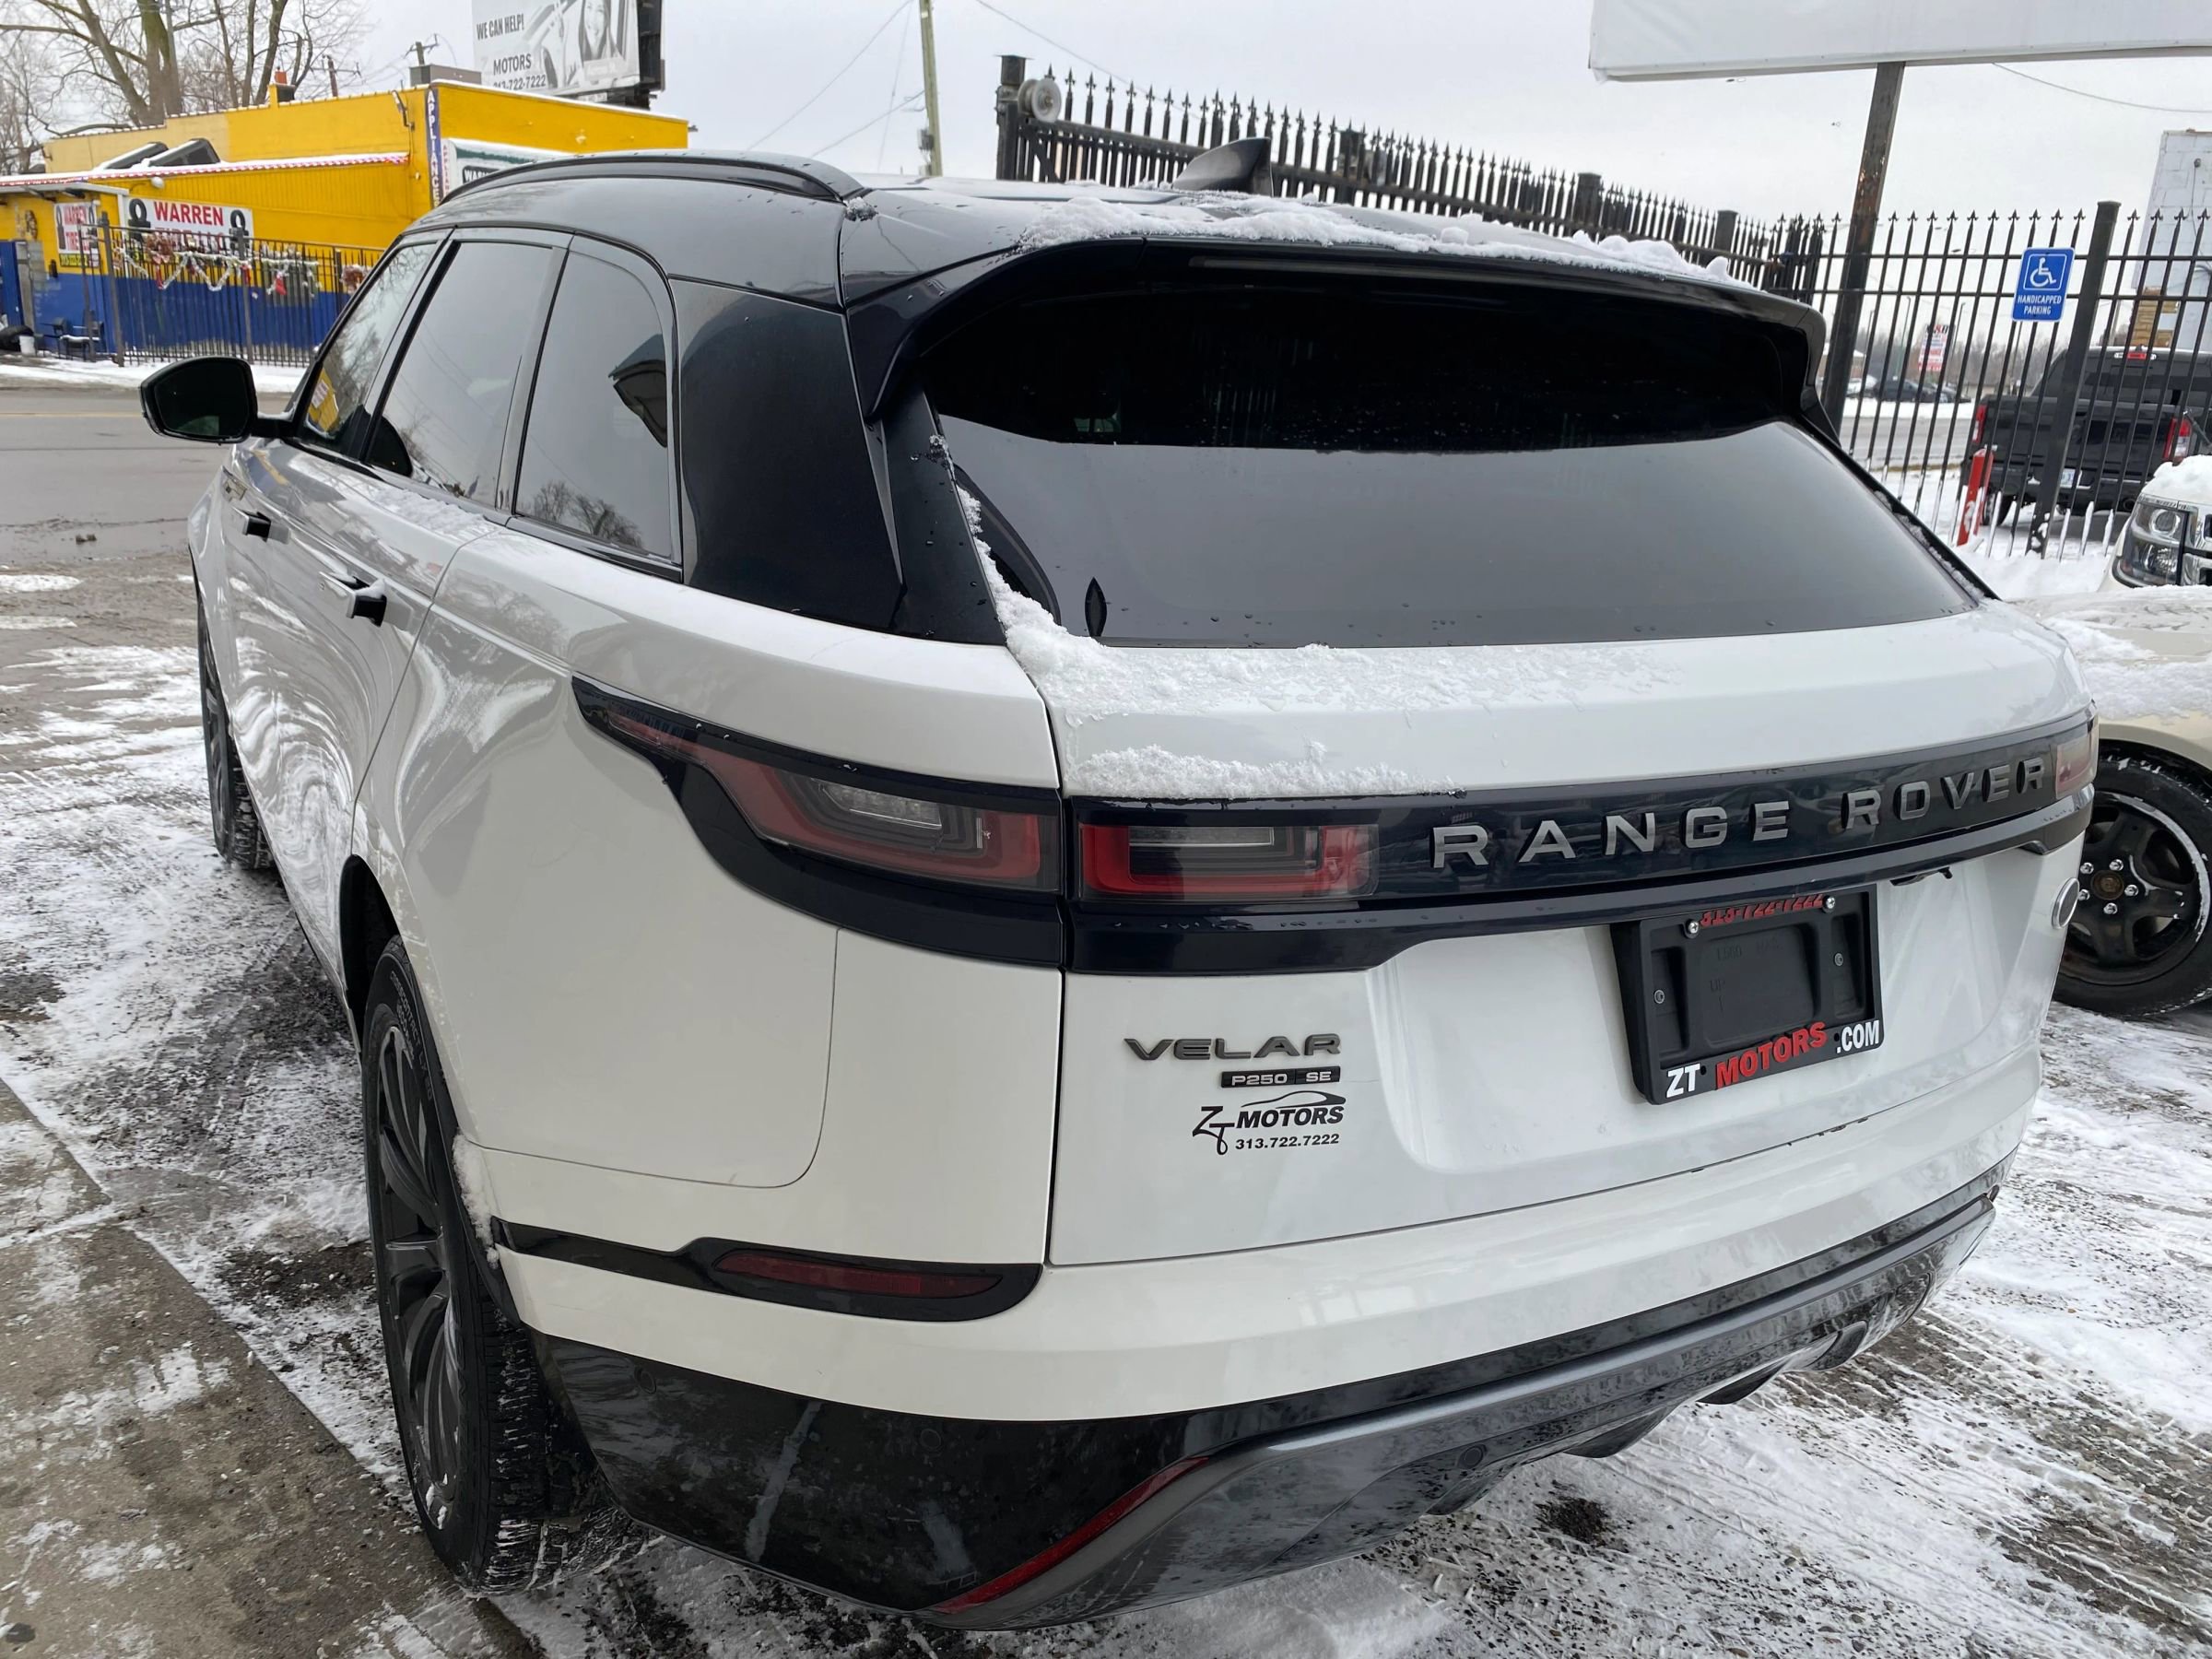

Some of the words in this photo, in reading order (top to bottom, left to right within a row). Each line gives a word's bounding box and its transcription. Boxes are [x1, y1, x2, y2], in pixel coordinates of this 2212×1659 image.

[477, 21, 488, 41] WE
[488, 18, 503, 38] CAN
[504, 14, 524, 34] HELP!
[493, 53, 532, 76] MOTORS
[153, 201, 224, 227] WARREN
[2018, 295, 2062, 304] HANDICAPPED
[2023, 305, 2052, 315] PARKING
[1430, 799, 1790, 869] RANGE
[1841, 757, 2046, 830] ROVER
[1124, 1032, 1342, 1061] VELAR
[1665, 1063, 1700, 1099] ZT
[1715, 1021, 1829, 1090] MOTORS
[1836, 1019, 1880, 1054] .COM
[1230, 1073, 1288, 1087] P250
[1305, 1070, 1332, 1082] SE
[1236, 1106, 1345, 1129] MOTORS
[1235, 1134, 1340, 1150] 313.722.7222
